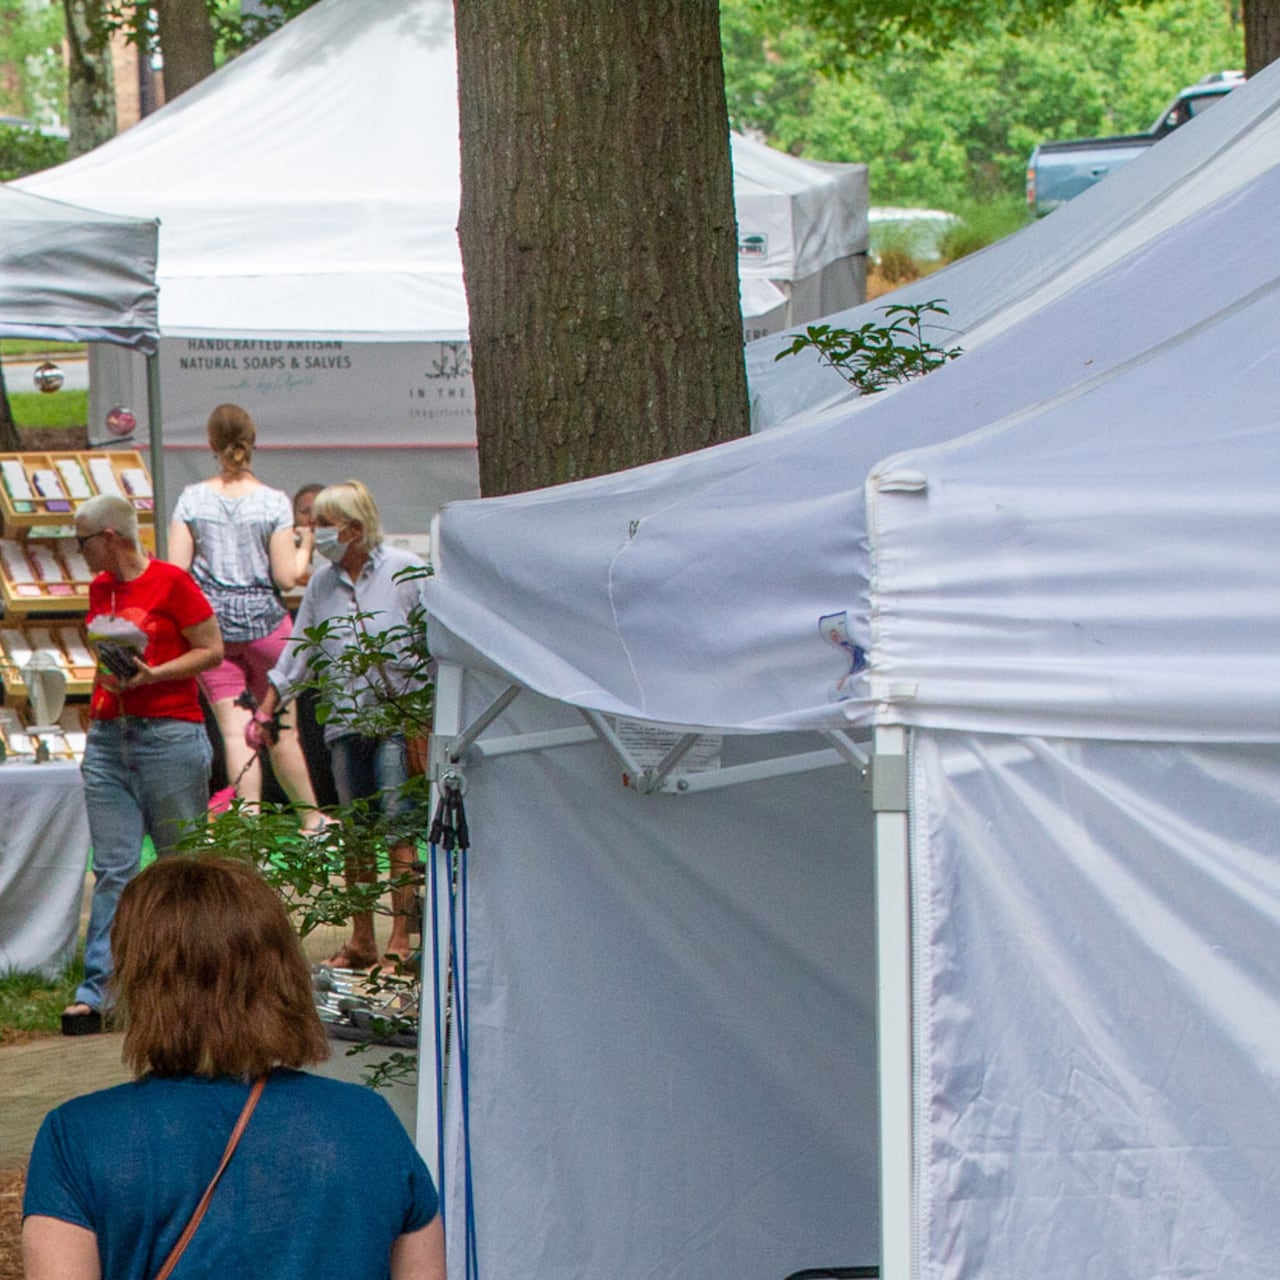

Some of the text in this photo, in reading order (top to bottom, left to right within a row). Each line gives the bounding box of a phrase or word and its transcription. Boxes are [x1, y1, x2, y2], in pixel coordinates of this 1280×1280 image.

[188, 339, 282, 350] HANDCRAFTED
[179, 356, 352, 370] NATURAL SOAPS & SALVES
[408, 389, 425, 398] IN
